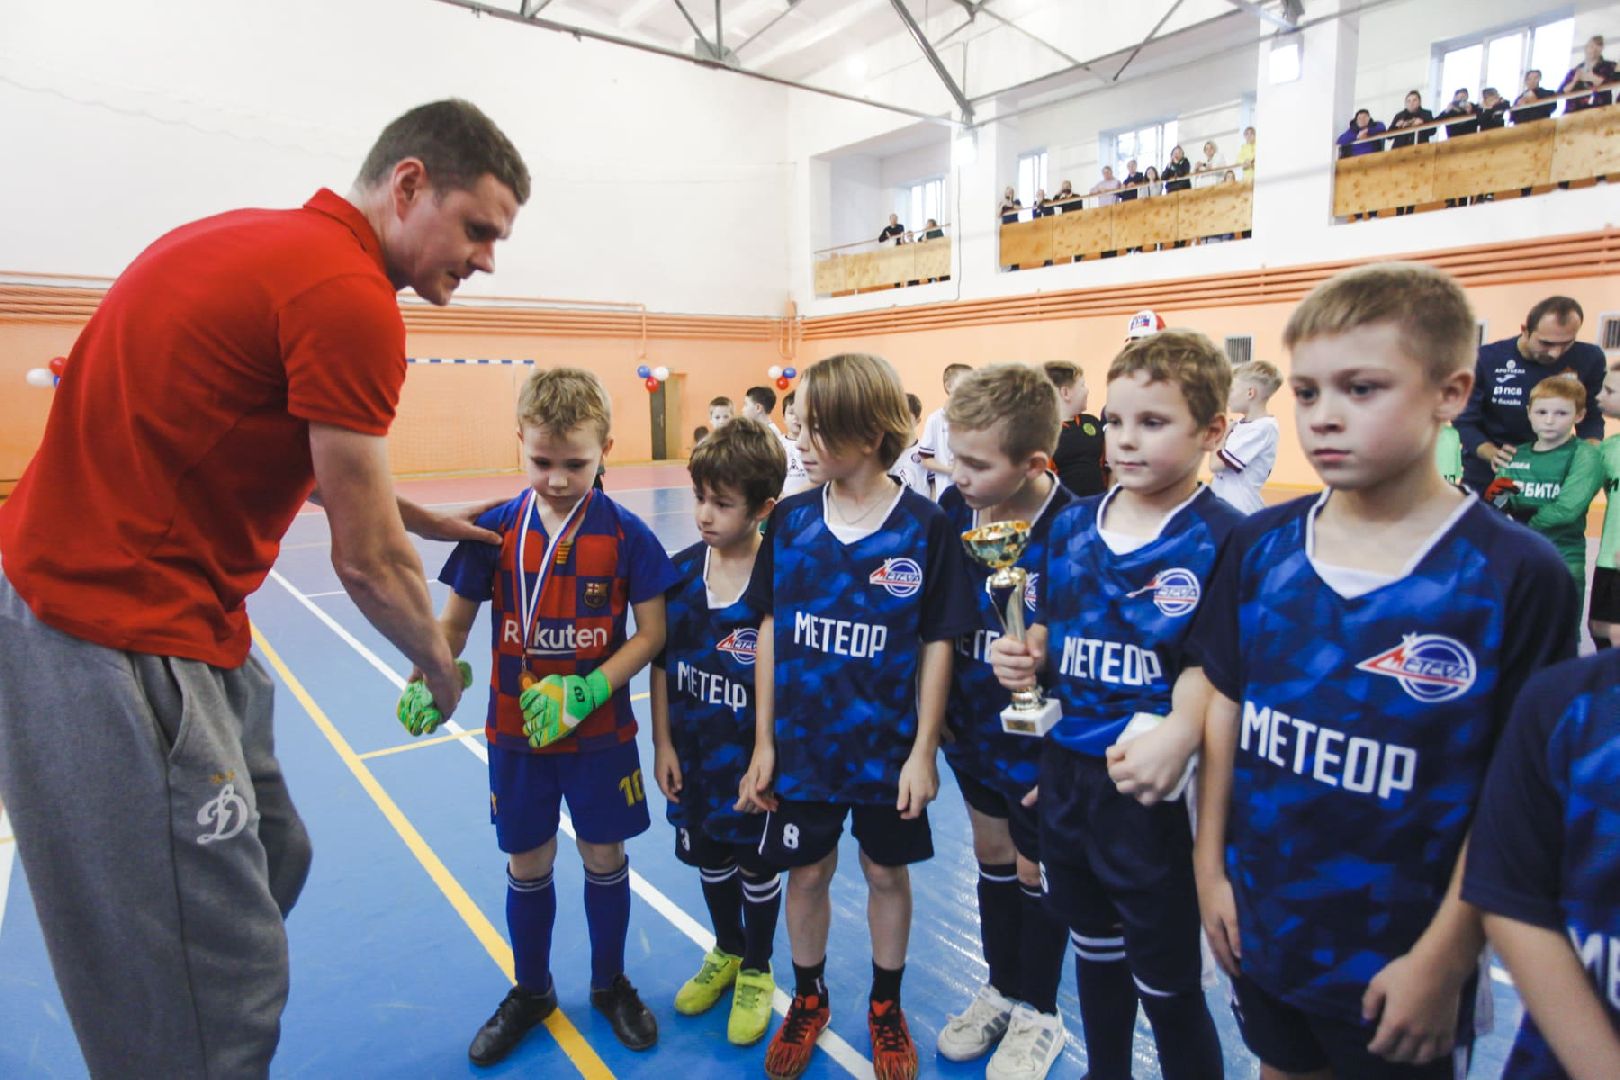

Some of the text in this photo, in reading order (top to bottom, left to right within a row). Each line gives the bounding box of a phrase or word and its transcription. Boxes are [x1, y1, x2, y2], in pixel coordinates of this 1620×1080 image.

[503, 619, 608, 649] Rkuten
[794, 611, 888, 658] МЕТЕОР
[1059, 636, 1162, 686] МЕТЕОР
[1240, 700, 1417, 800] МЕТЕОР
[782, 823, 800, 849] 8
